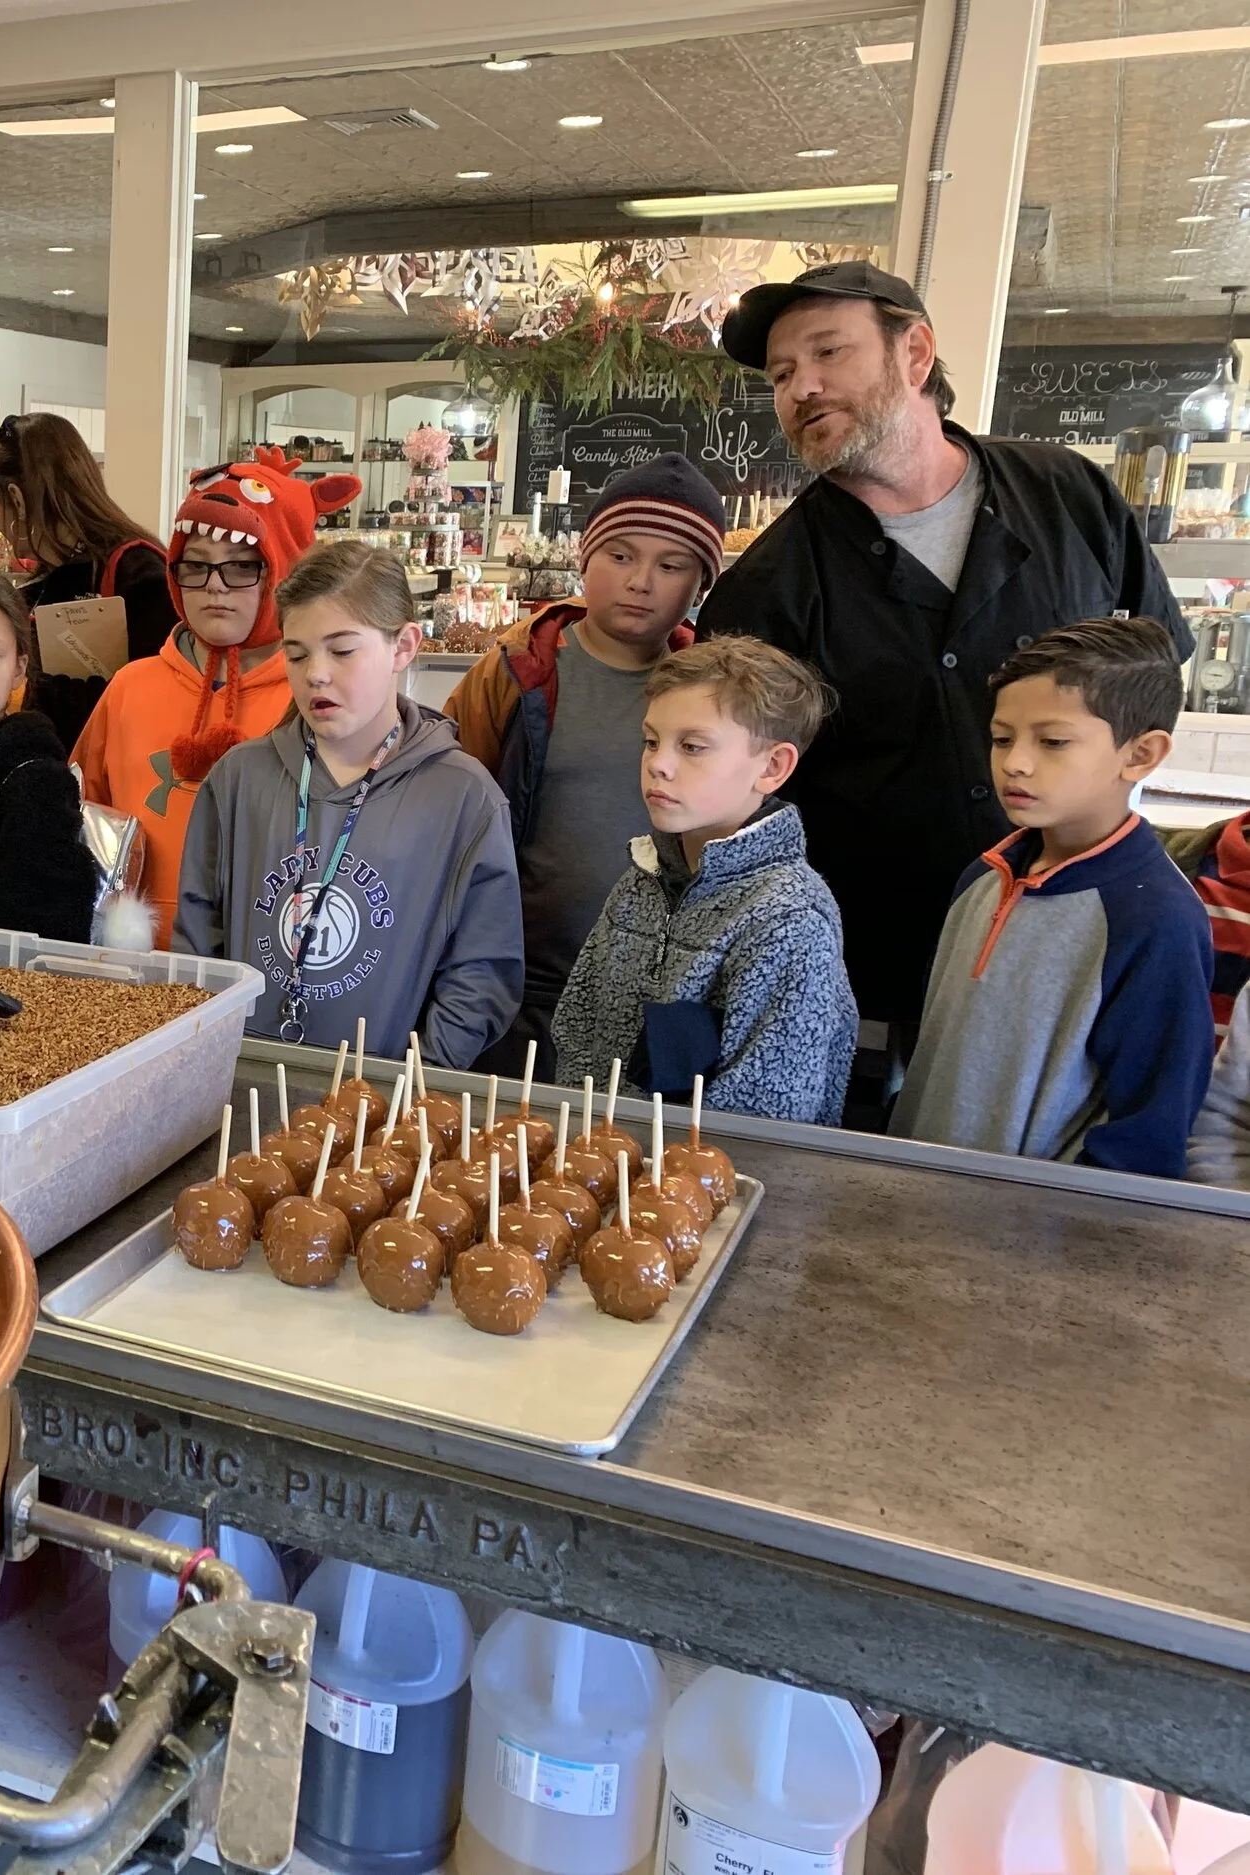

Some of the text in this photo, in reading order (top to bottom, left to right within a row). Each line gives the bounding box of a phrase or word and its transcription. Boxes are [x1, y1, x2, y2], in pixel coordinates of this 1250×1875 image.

[1013, 360, 1168, 394] SWEETS
[602, 428, 652, 437] THE OLD MILL
[1059, 410, 1105, 423] OLD MILL
[572, 445, 662, 468] Candy Kitch
[701, 407, 770, 482] Life
[254, 845, 395, 929] LADY CUBS
[301, 925, 330, 957] 21
[257, 935, 382, 1000] BASKETBALL
[282, 1464, 444, 1545] PHILA
[715, 1852, 754, 1874] Cherry
